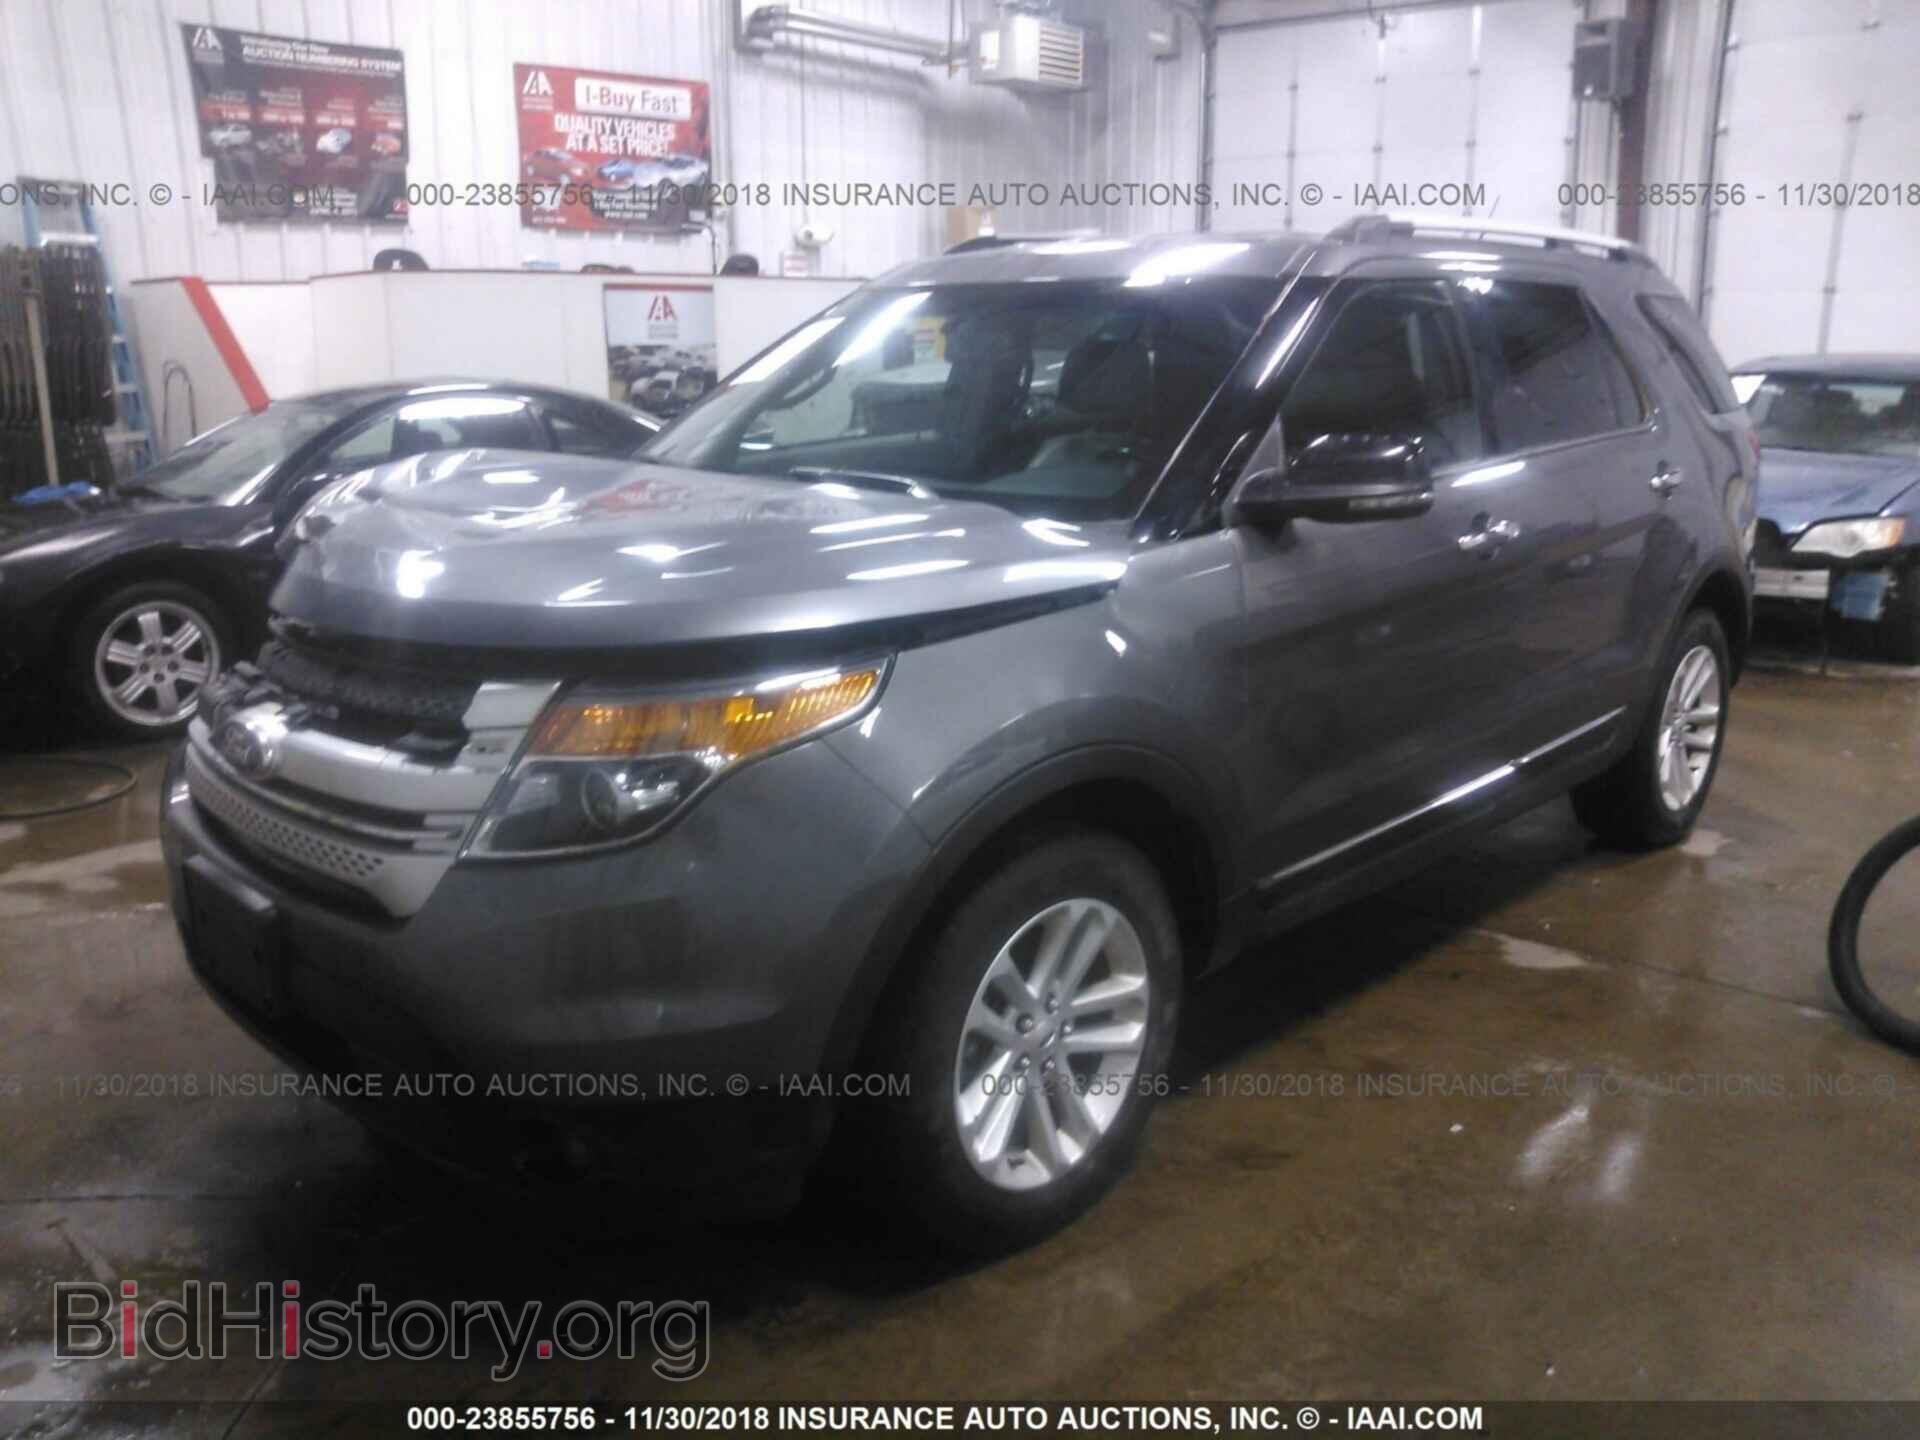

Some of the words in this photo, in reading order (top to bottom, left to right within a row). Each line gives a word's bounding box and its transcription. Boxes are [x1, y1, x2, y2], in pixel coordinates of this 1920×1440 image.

[585, 84, 636, 111] I-Buy
[640, 90, 678, 114] Fast
[554, 113, 613, 137] QUALITY
[613, 119, 676, 141] VEHICLES
[565, 134, 584, 152] AT
[585, 135, 598, 152] A
[599, 135, 625, 155] SET
